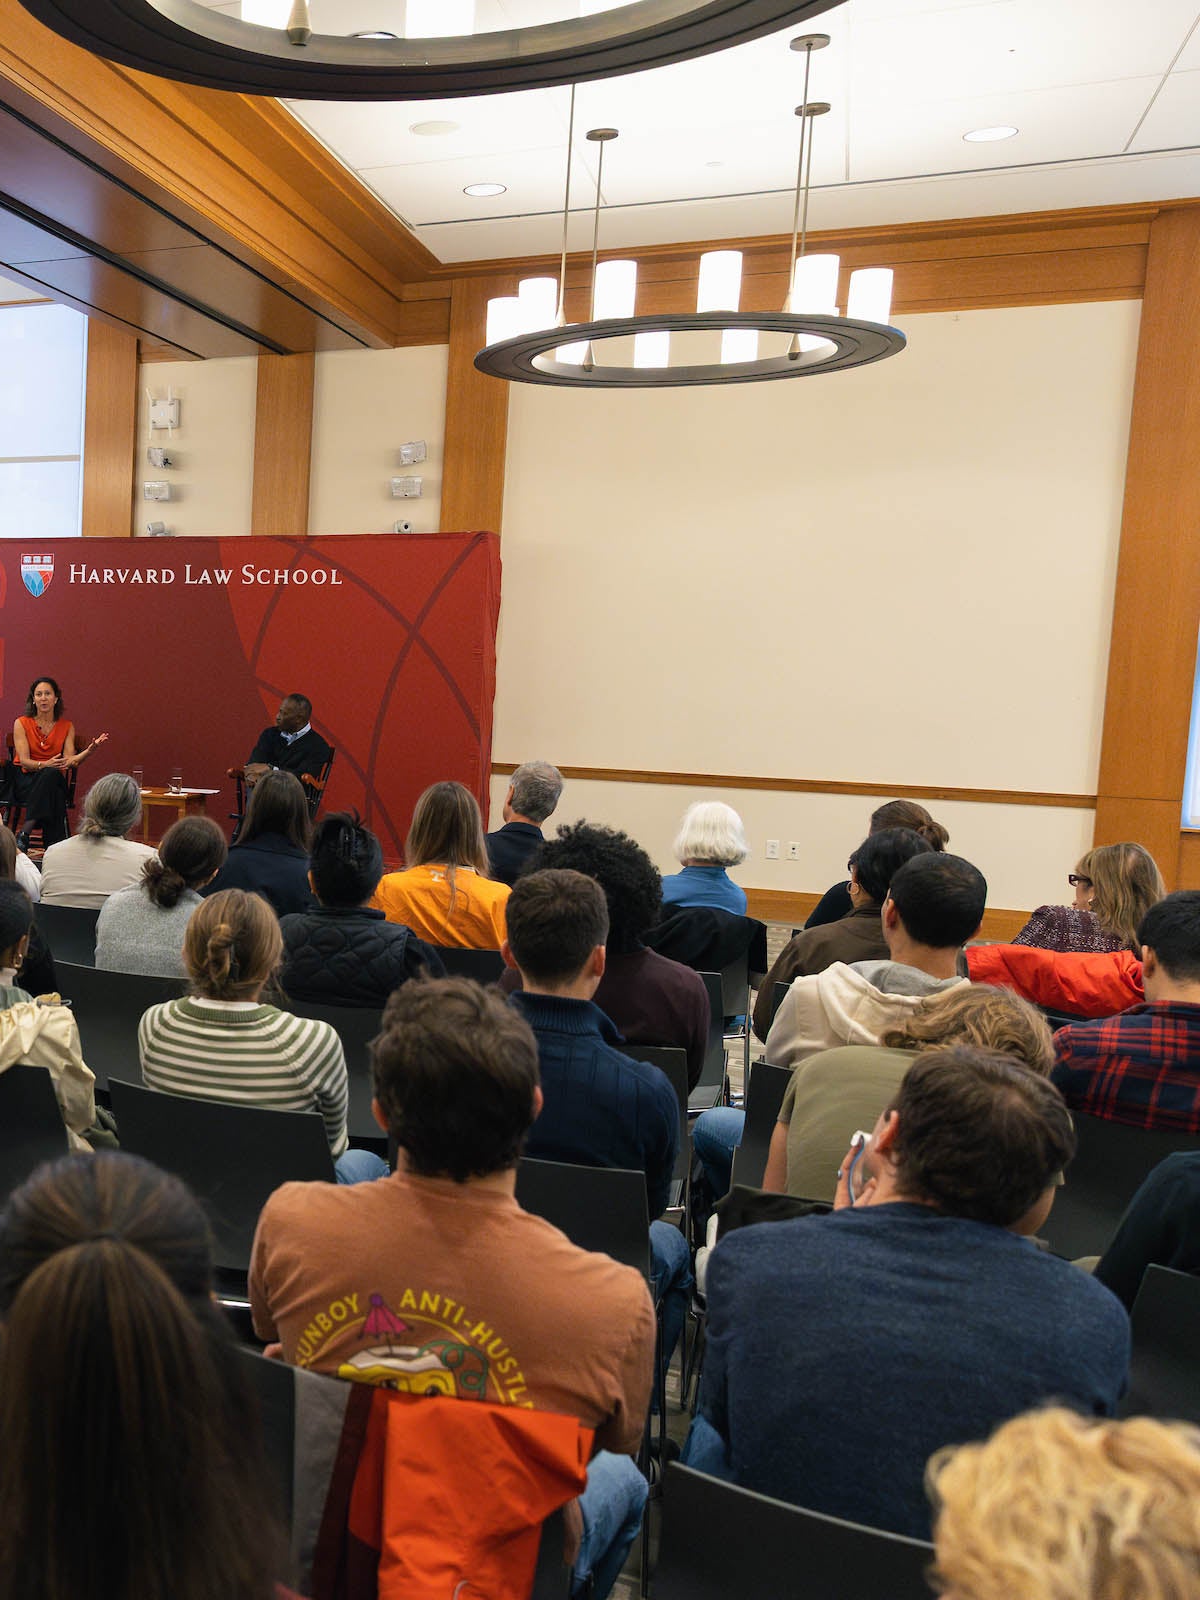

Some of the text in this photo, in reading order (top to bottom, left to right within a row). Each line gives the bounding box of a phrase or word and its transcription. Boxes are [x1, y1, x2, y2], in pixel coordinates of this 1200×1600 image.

[69, 564, 343, 585] HARVARD LAW SCHOOL
[399, 1287, 534, 1409] ANTI-HUSTL
